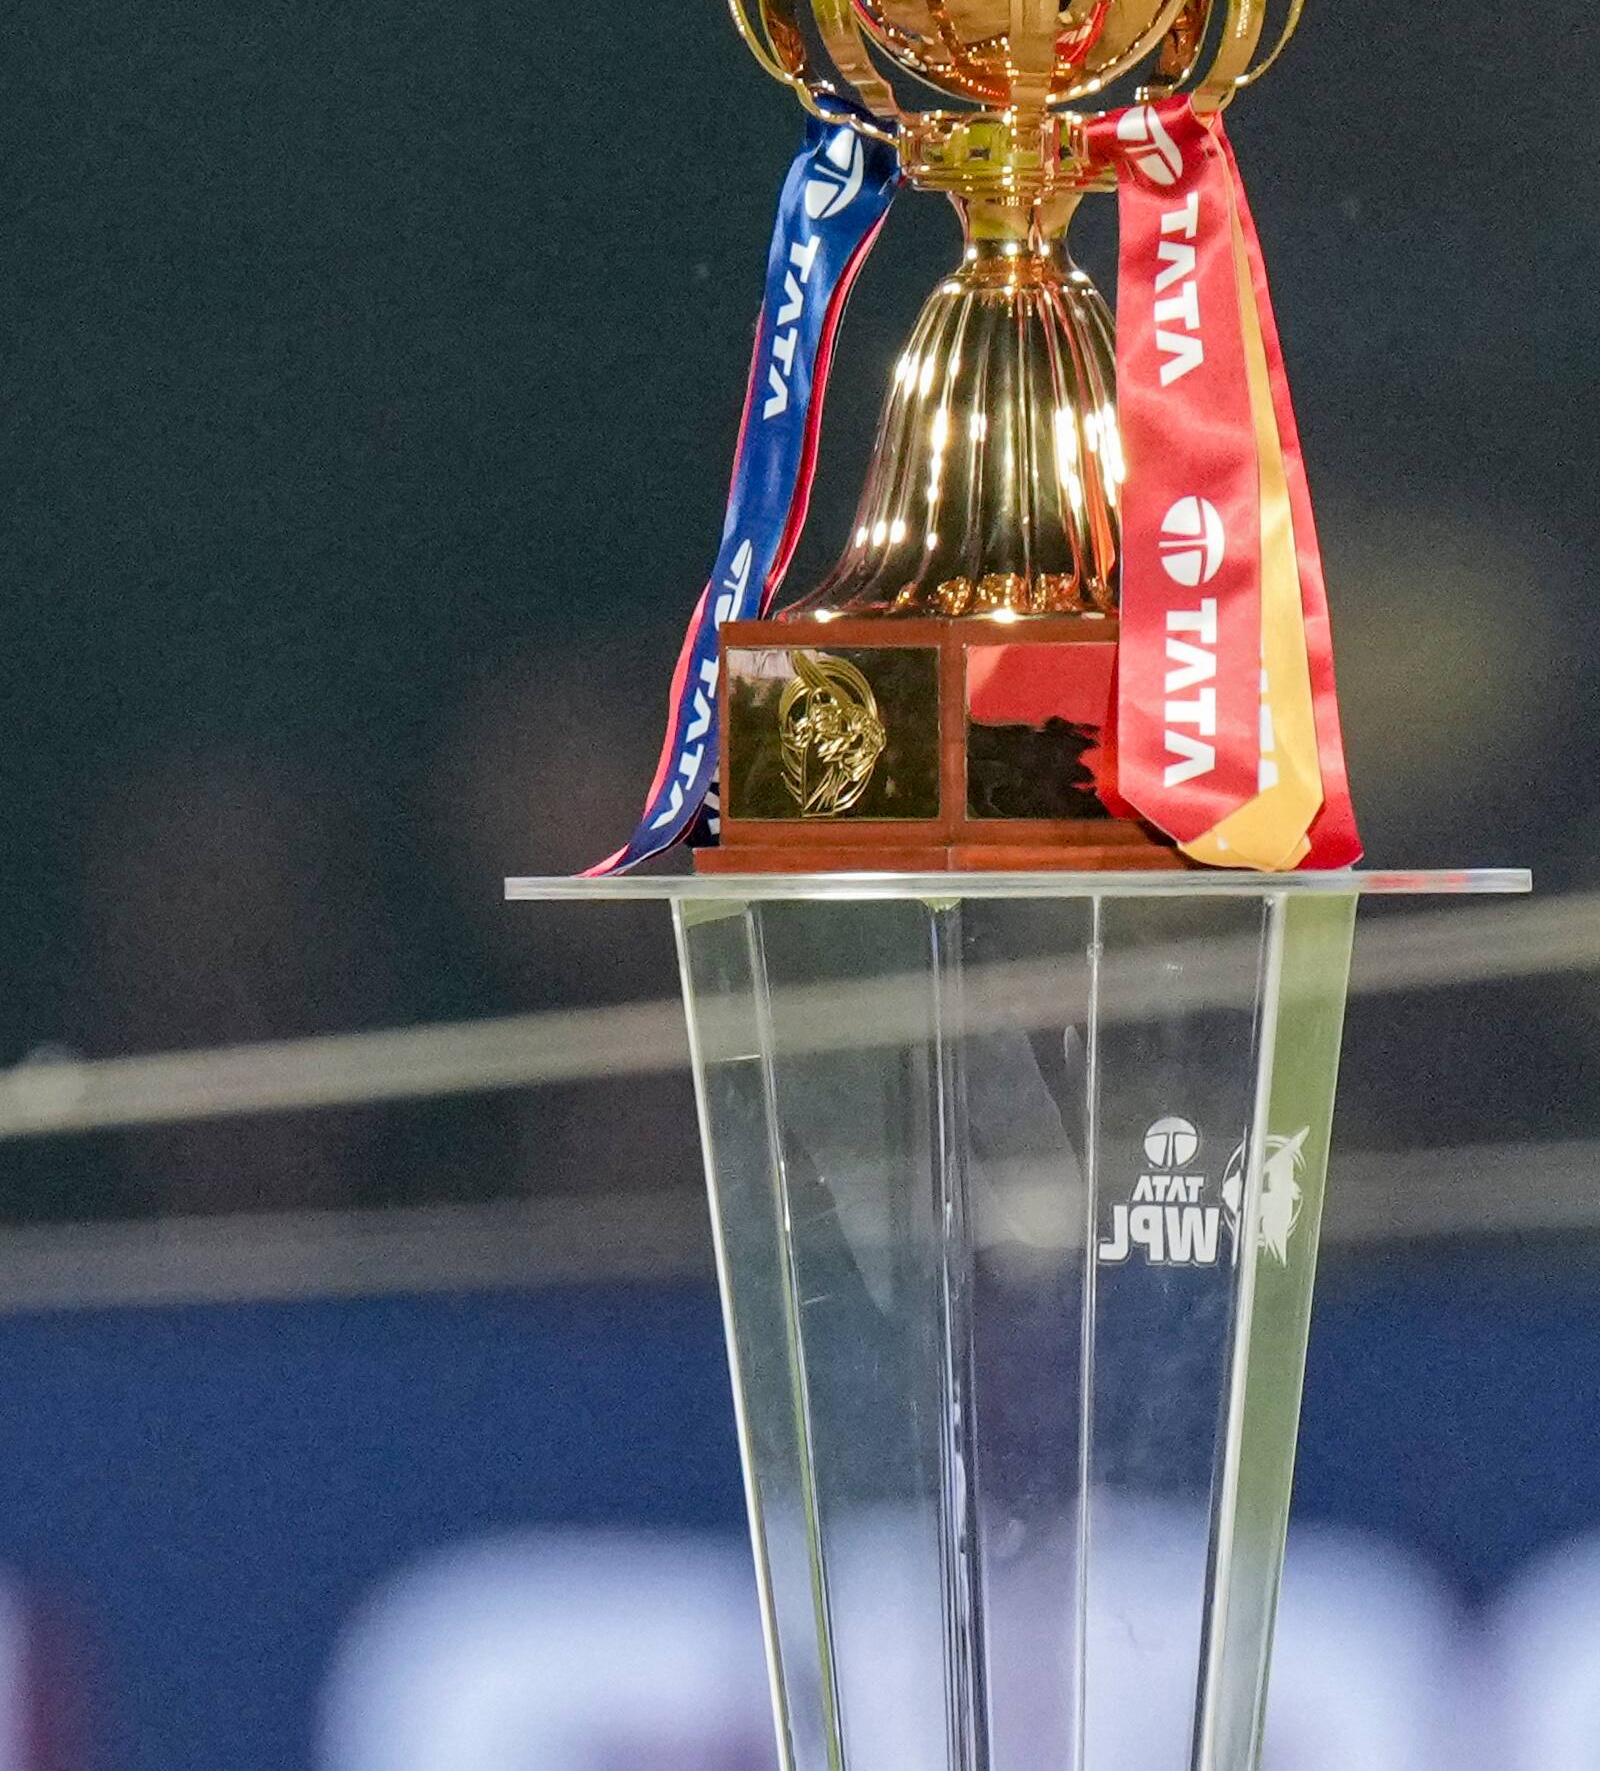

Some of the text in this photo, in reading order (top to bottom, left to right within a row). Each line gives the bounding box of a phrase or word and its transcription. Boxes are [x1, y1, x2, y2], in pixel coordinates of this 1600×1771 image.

[763, 235, 821, 420] TATA
[1154, 191, 1204, 387] TATA
[650, 656, 720, 830] TATA
[1163, 597, 1217, 788] TATA
